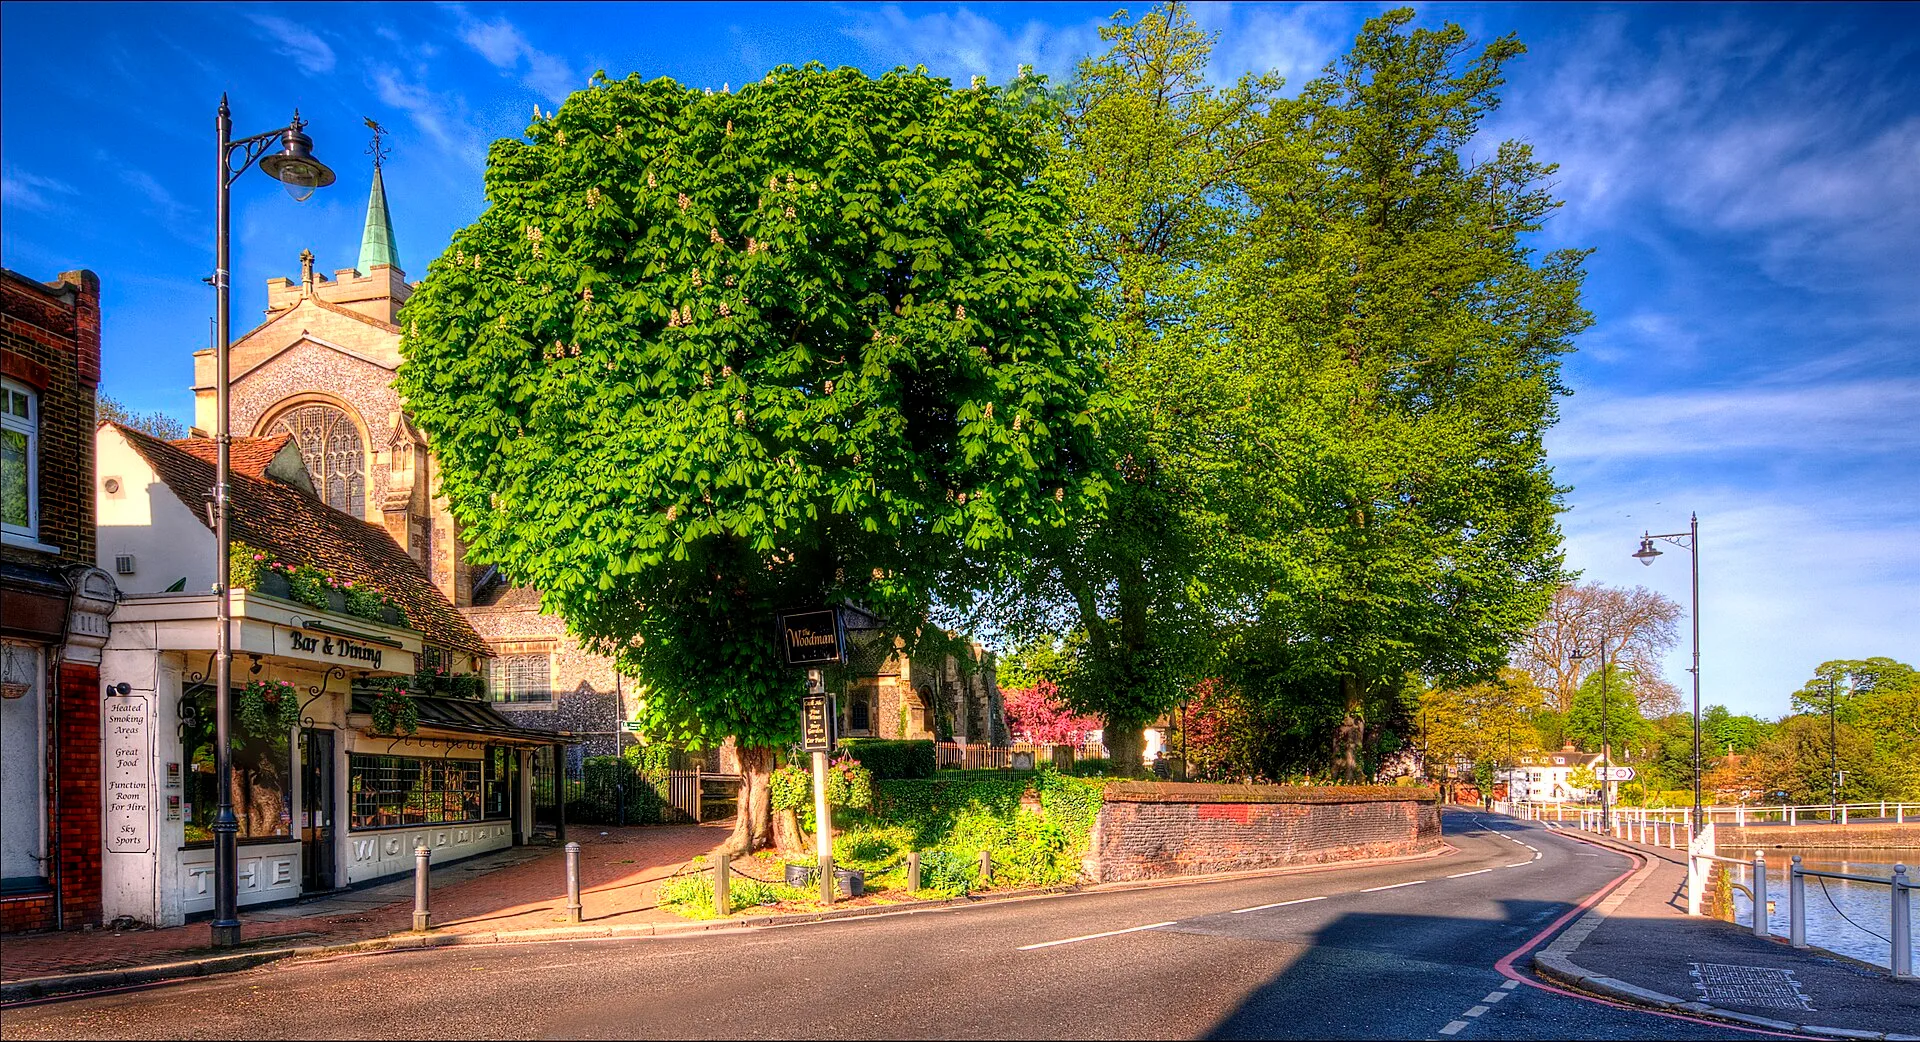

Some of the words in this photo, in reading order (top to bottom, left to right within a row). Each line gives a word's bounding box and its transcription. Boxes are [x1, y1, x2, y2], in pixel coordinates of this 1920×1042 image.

[786, 628, 834, 648] Woodman
[290, 630, 319, 653] Bar
[322, 636, 334, 655] &
[337, 638, 382, 669] Dining
[111, 702, 143, 712] Heated
[109, 714, 144, 725] Smoking
[114, 726, 139, 734] Areas
[115, 748, 138, 757] Great
[116, 759, 139, 768] Food
[109, 781, 146, 790] Function
[115, 792, 140, 800] Room
[109, 803, 125, 812] For
[126, 802, 146, 811] Hire
[120, 824, 136, 835] Sky
[115, 836, 141, 846] Sports
[352, 828, 505, 862] WOODMAN
